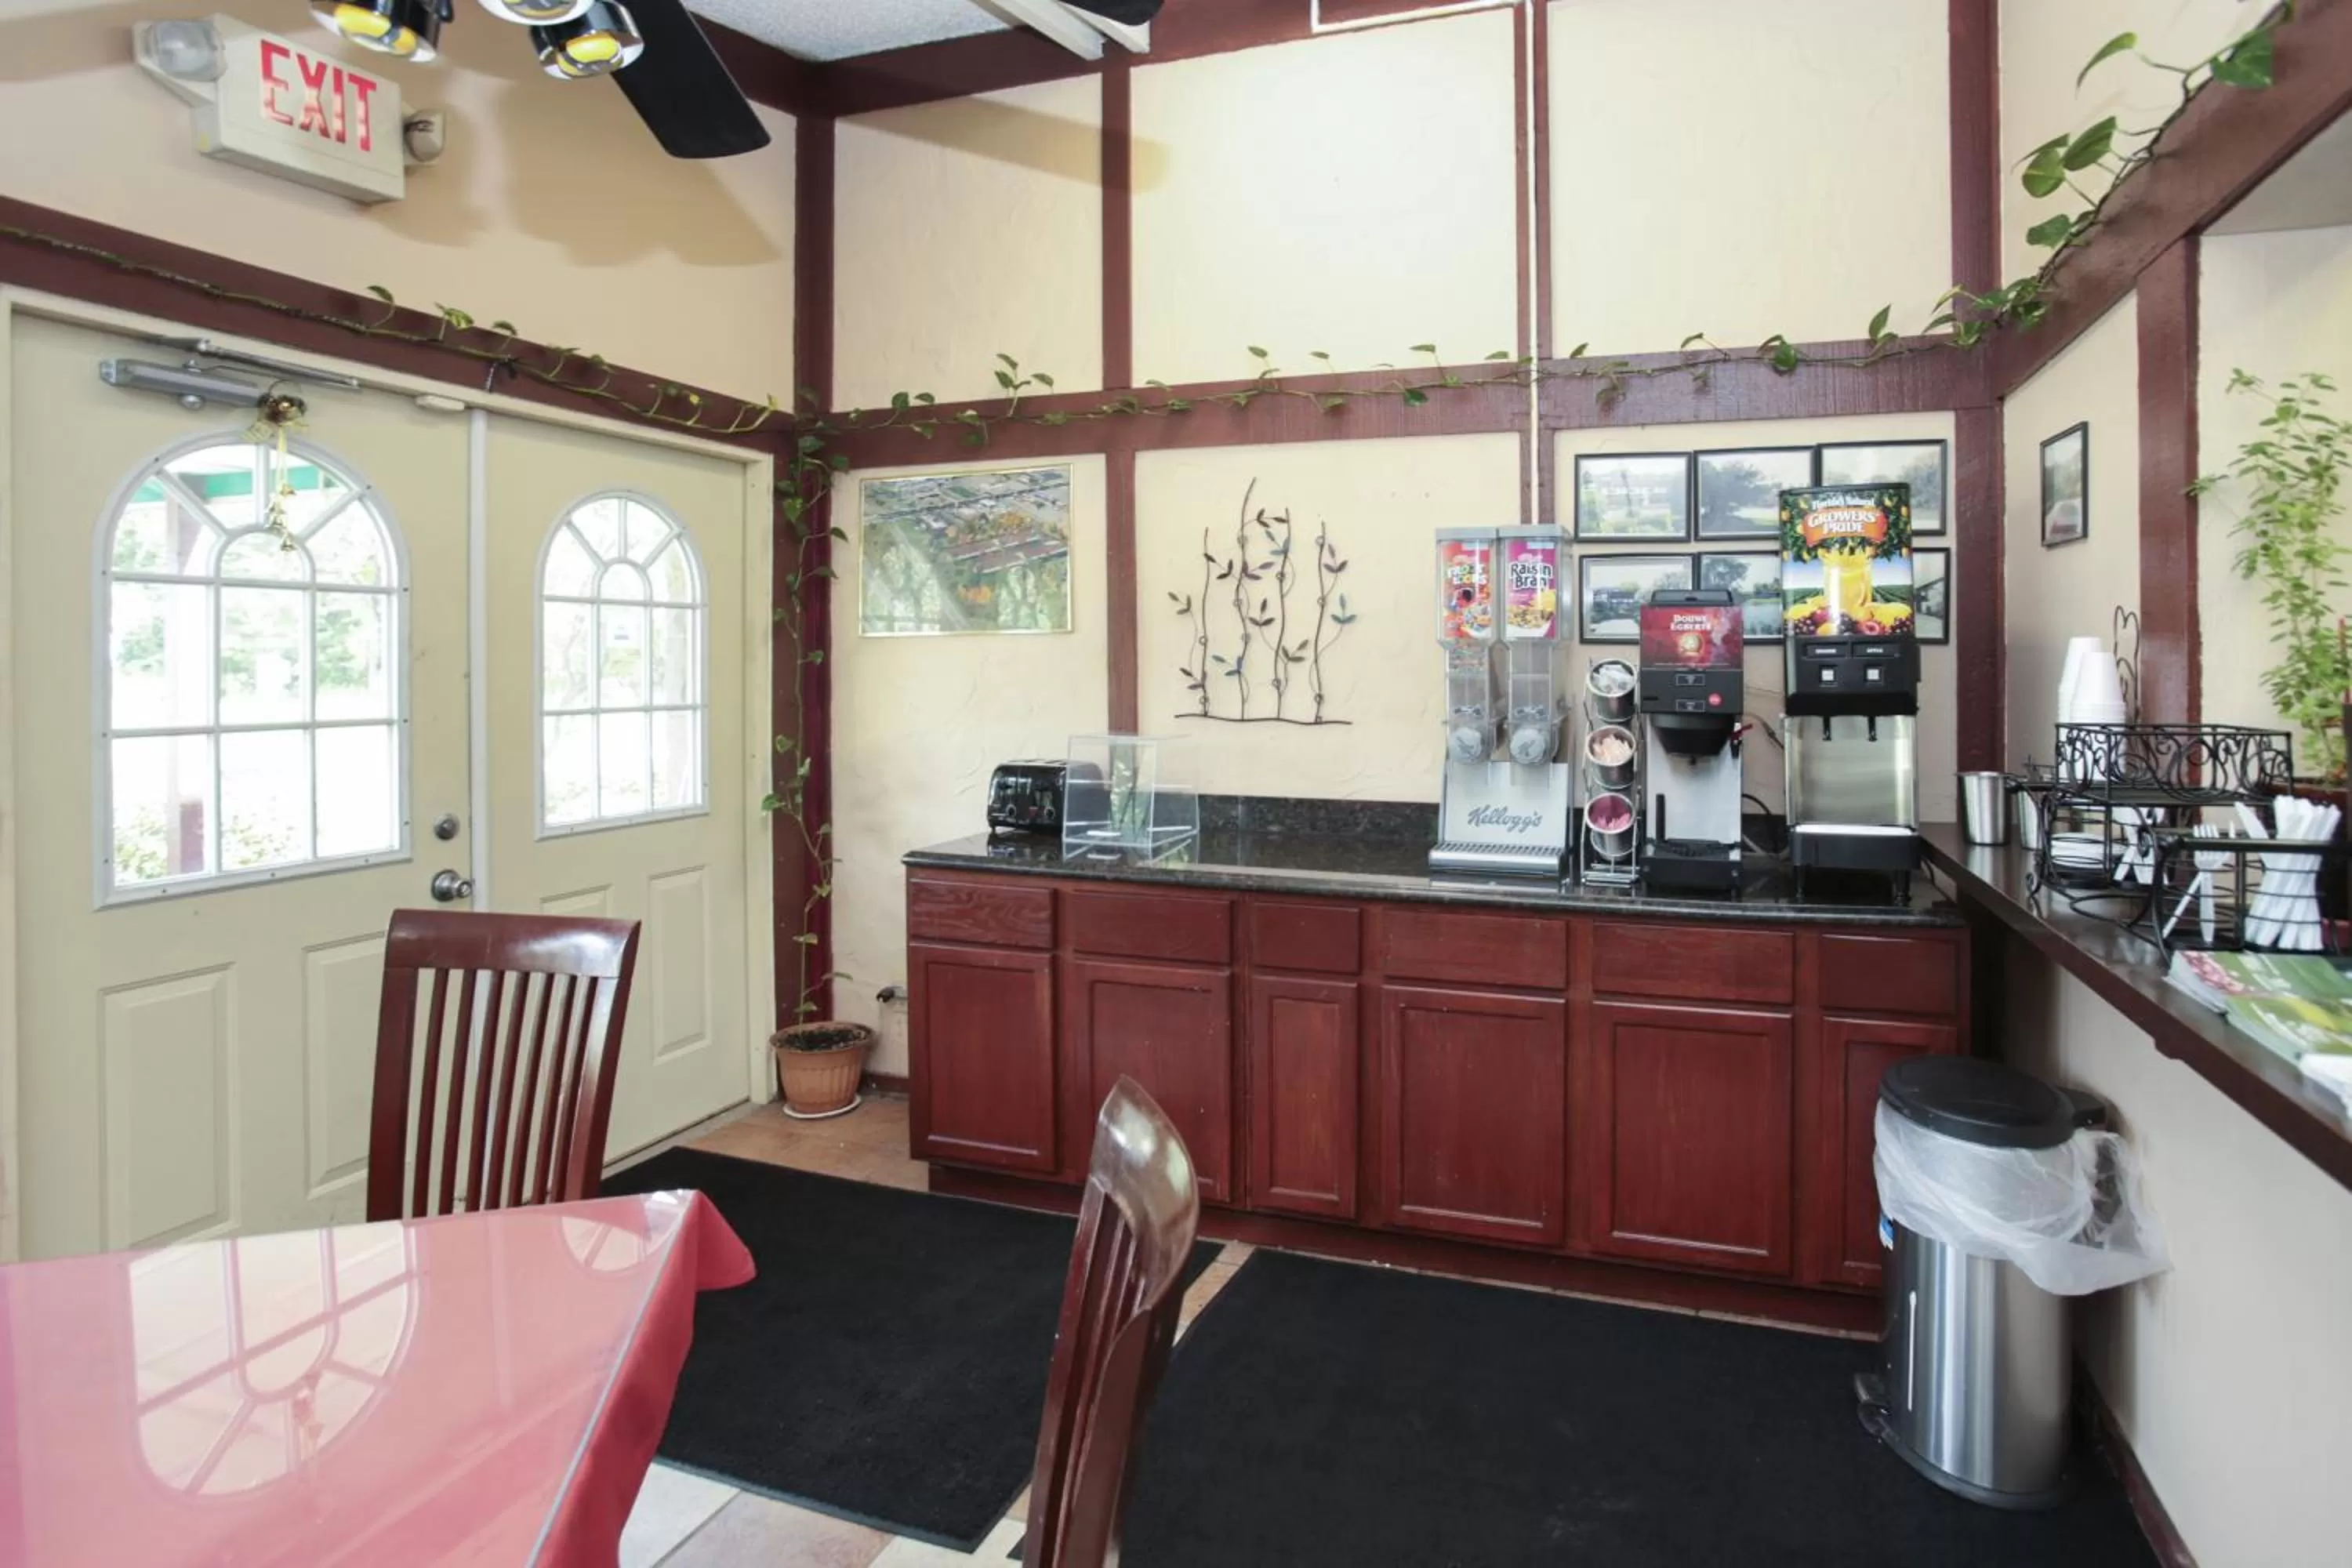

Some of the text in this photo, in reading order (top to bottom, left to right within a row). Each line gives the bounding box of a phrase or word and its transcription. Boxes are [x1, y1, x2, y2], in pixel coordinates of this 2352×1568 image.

[260, 39, 377, 152] EXIT
[1822, 521, 1865, 535] PRIDE
[1515, 576, 1548, 589] Bran
[1467, 804, 1543, 833] Kellogg's
